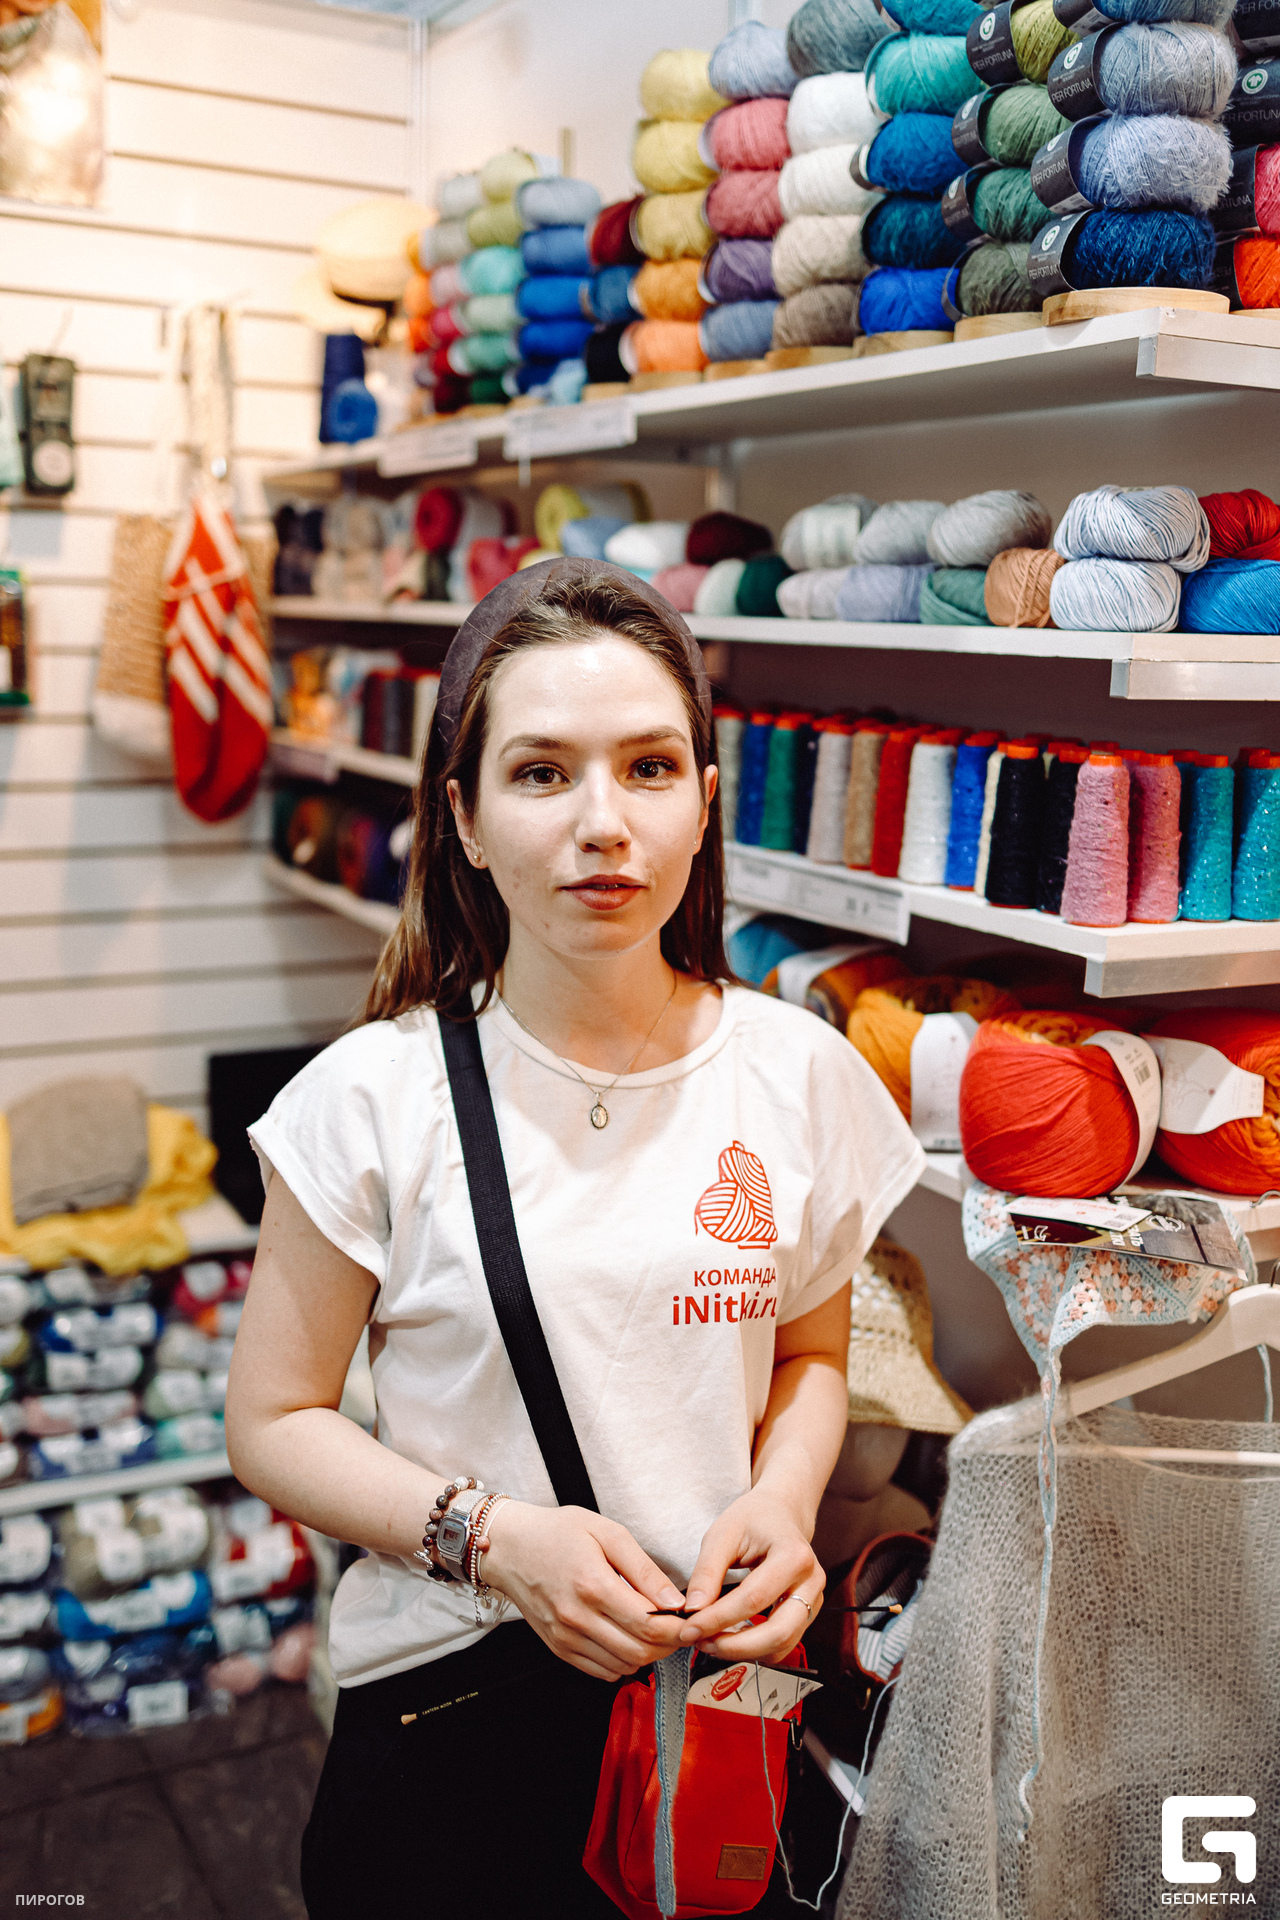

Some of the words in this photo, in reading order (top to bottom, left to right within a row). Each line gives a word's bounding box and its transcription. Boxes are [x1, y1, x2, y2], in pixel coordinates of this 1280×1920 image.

[972, 59, 985, 71] PER
[984, 49, 1014, 67] FORTUNA
[1052, 91, 1065, 103] PER
[1064, 78, 1093, 98] FORTUNA
[1032, 173, 1044, 186] PER
[1043, 159, 1068, 180] FORTUNA
[1038, 264, 1060, 277] FORTUNA
[694, 1267, 776, 1288] КОМАНДА
